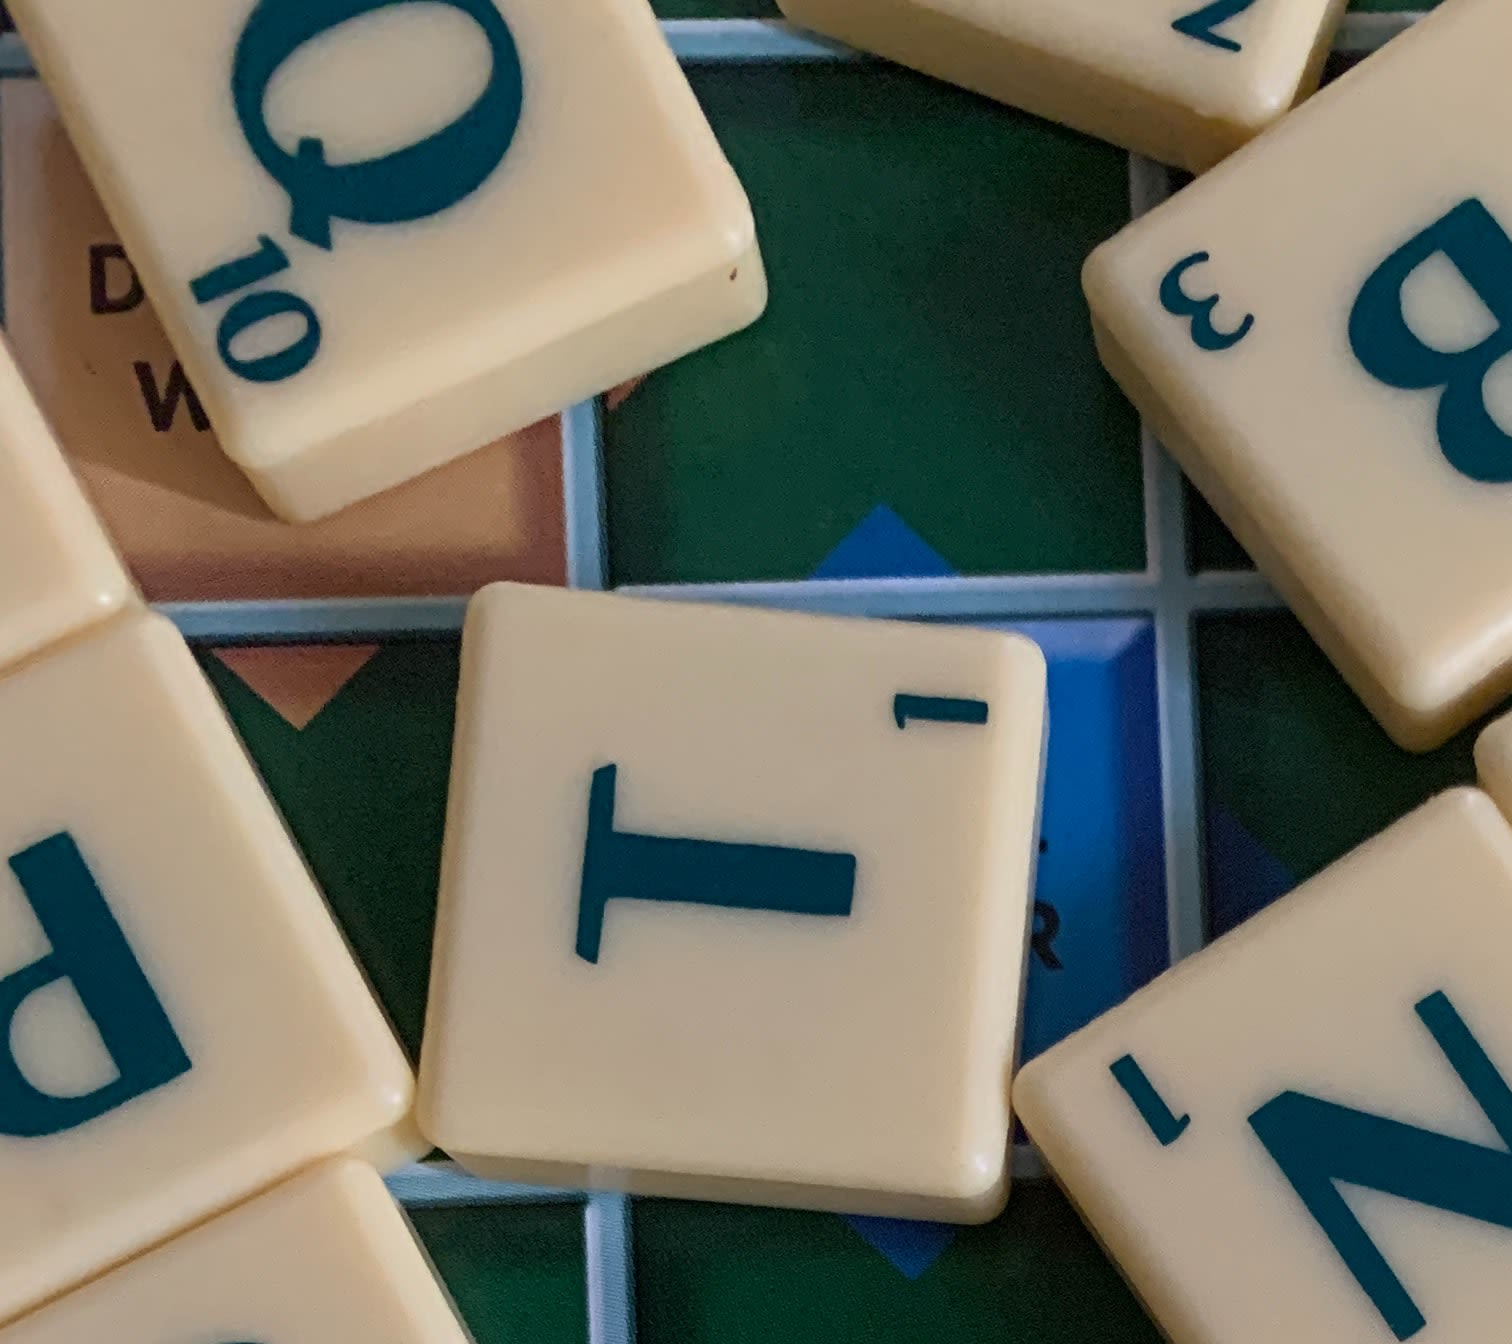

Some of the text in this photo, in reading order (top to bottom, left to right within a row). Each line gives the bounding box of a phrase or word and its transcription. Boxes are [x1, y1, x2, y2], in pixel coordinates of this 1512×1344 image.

[232, 0, 523, 250] Q
[190, 235, 322, 383] 10
[1160, 253, 1252, 350] 3
[894, 693, 988, 730] 1
[576, 763, 856, 963] T
[0, 832, 192, 1137] P
[1111, 1055, 1189, 1145] 1
